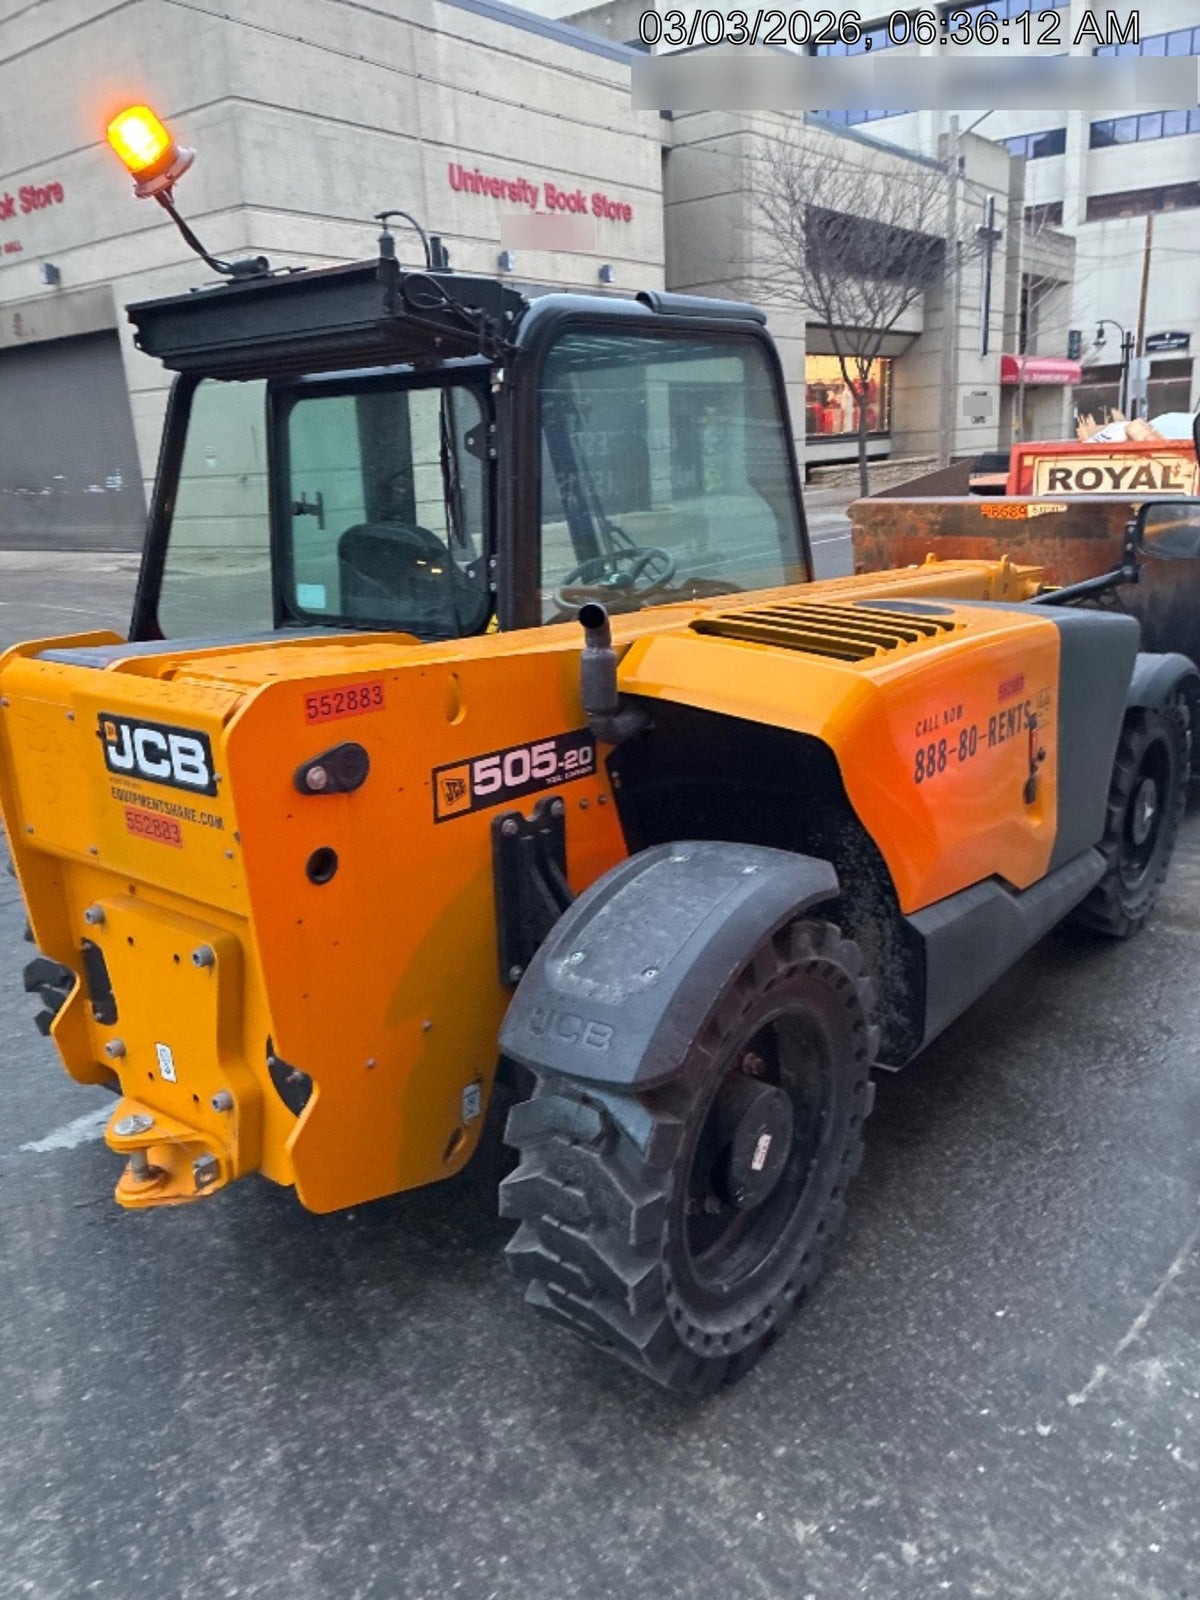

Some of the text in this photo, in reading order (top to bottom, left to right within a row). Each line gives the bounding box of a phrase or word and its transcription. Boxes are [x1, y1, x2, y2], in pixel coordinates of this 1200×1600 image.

[18, 181, 64, 214] Store
[448, 163, 632, 222] University Book Store
[1047, 463, 1185, 491] ROYAL
[305, 685, 384, 719] 552883
[915, 703, 963, 738] CALL NOW
[107, 723, 210, 787] JCB
[914, 699, 1033, 784] 888-80-RENTS
[110, 786, 225, 831] EQUIPMENTSHARE.COM
[125, 810, 181, 843] 552883
[528, 1006, 615, 1052] JCB
